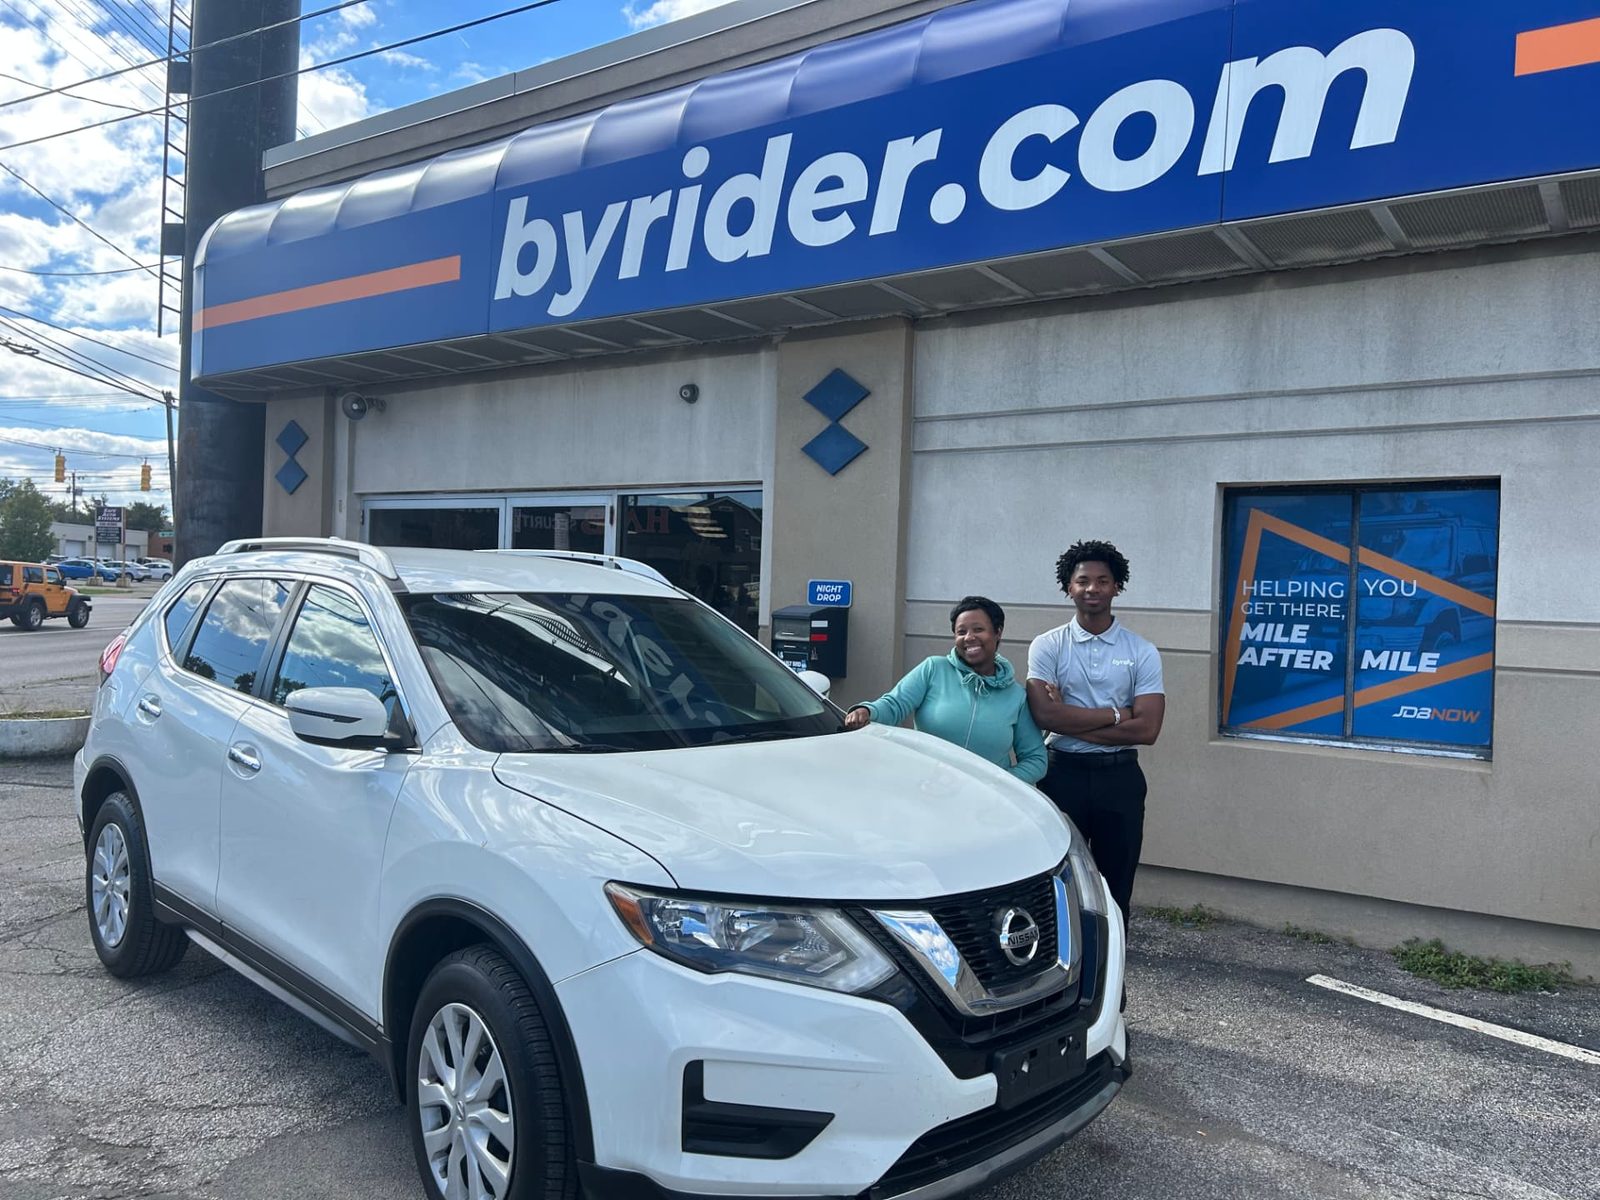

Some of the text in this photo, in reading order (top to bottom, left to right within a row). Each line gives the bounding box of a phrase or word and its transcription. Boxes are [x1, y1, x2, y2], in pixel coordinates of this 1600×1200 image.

[493, 28, 1415, 317] byrider.com
[816, 584, 843, 593] NIGHT
[816, 593, 841, 602] DROP
[1242, 579, 1417, 598] HELPING YOU
[1241, 602, 1345, 620] GET THERE,
[1239, 622, 1310, 643] MILE
[1237, 647, 1440, 673] AFTER MILE
[1007, 928, 1039, 945] NISSAN
